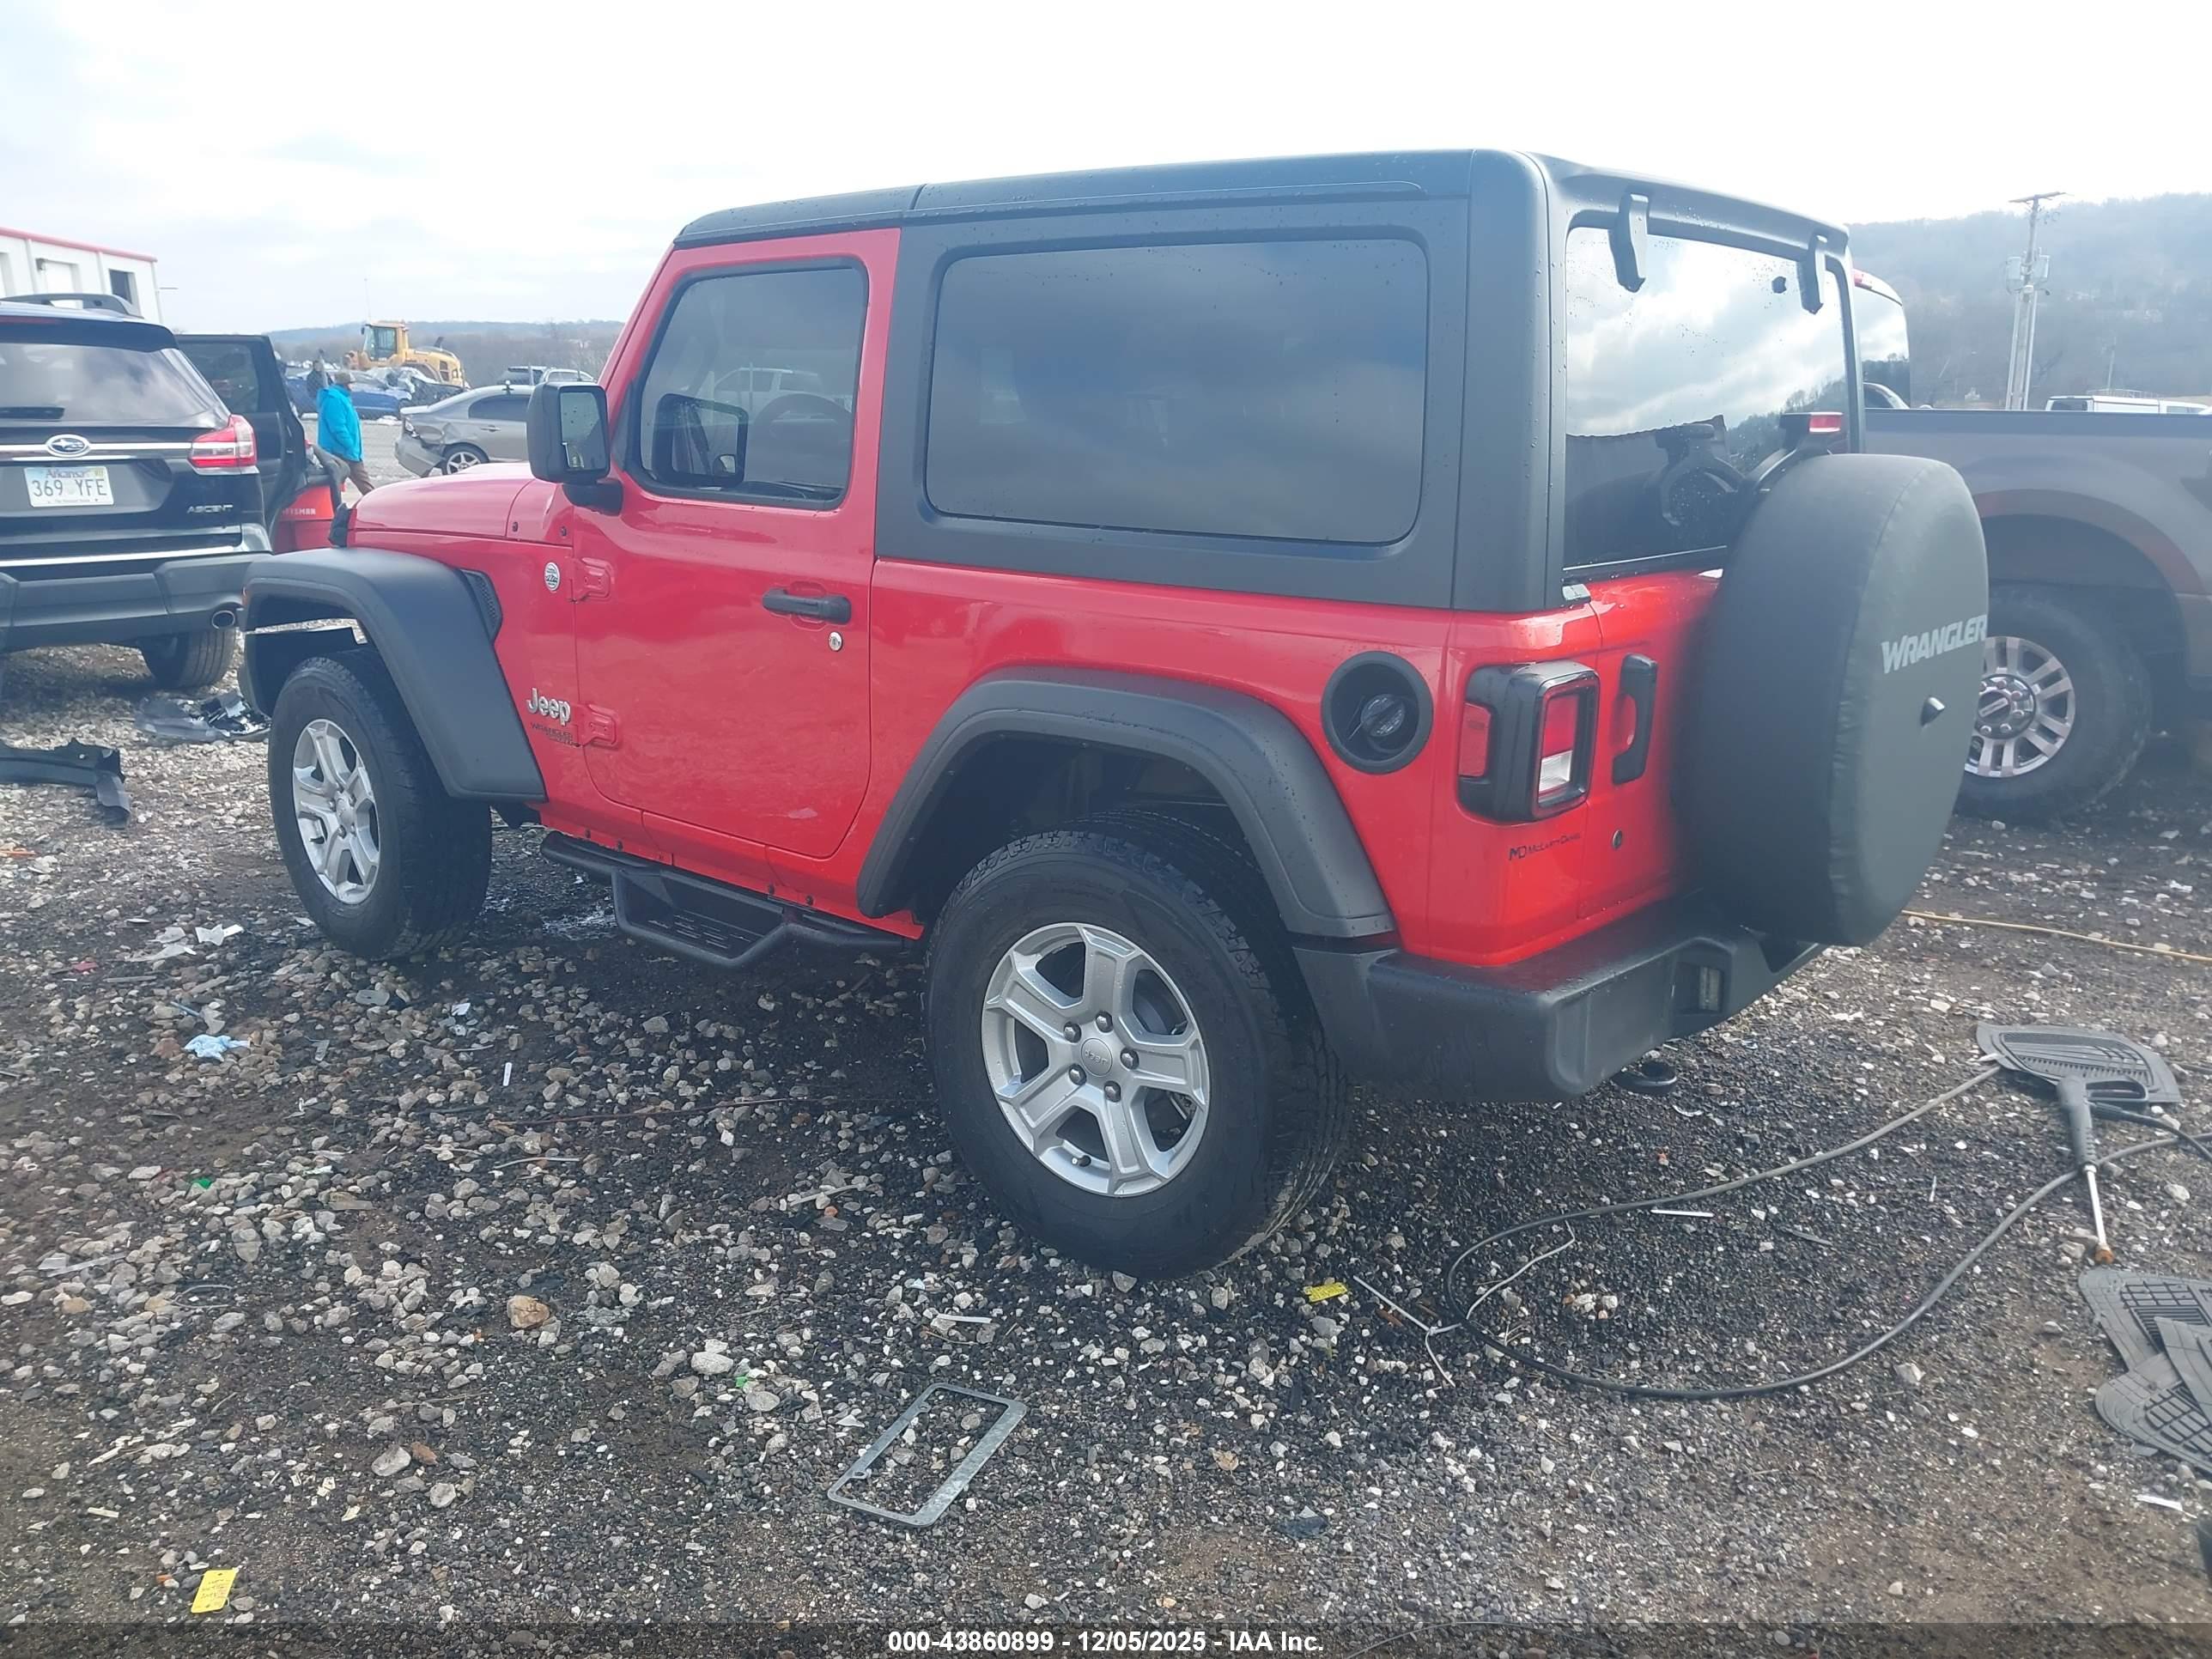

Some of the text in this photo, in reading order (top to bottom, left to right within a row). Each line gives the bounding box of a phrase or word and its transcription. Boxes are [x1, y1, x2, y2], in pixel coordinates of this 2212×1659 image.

[32, 478, 107, 497] 369 YFE
[186, 503, 234, 514] ASCENT
[1881, 614, 1988, 674] WRANGLER
[526, 687, 571, 726] Jeep
